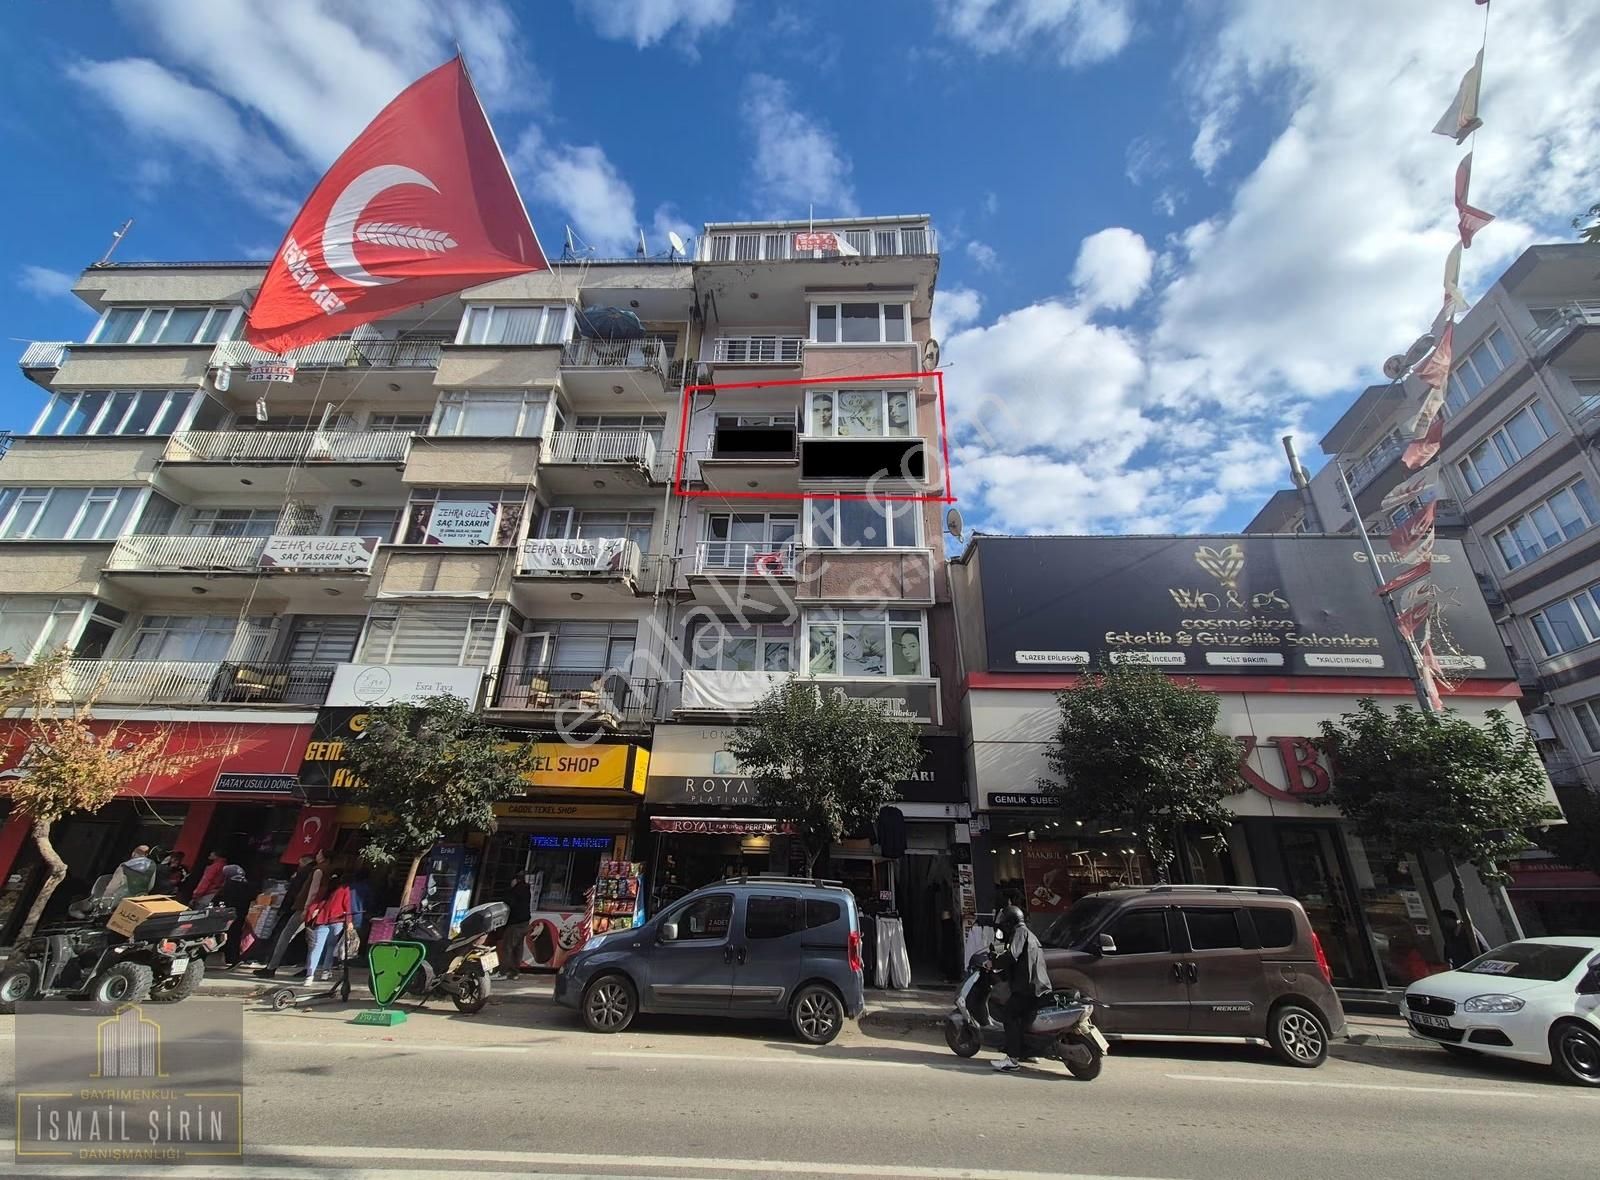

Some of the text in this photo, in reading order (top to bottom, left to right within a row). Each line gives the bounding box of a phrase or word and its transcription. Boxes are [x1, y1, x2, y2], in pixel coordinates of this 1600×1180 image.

[438, 508, 490, 520] ZEHRA GÜLER
[436, 519, 490, 528] SAÇ TASARIM
[271, 540, 357, 554] ZEHRA GÜLER
[524, 544, 597, 557] ZEHRA GÜLER
[280, 553, 343, 562] SAÇ TASARIM
[551, 557, 596, 567] SAÇ TASARIM
[557, 756, 600, 773] SHOP
[219, 778, 244, 789] HATAY
[244, 777, 270, 789] USULÜ
[557, 807, 577, 815] SHOP
[675, 821, 714, 831] ROYAL
